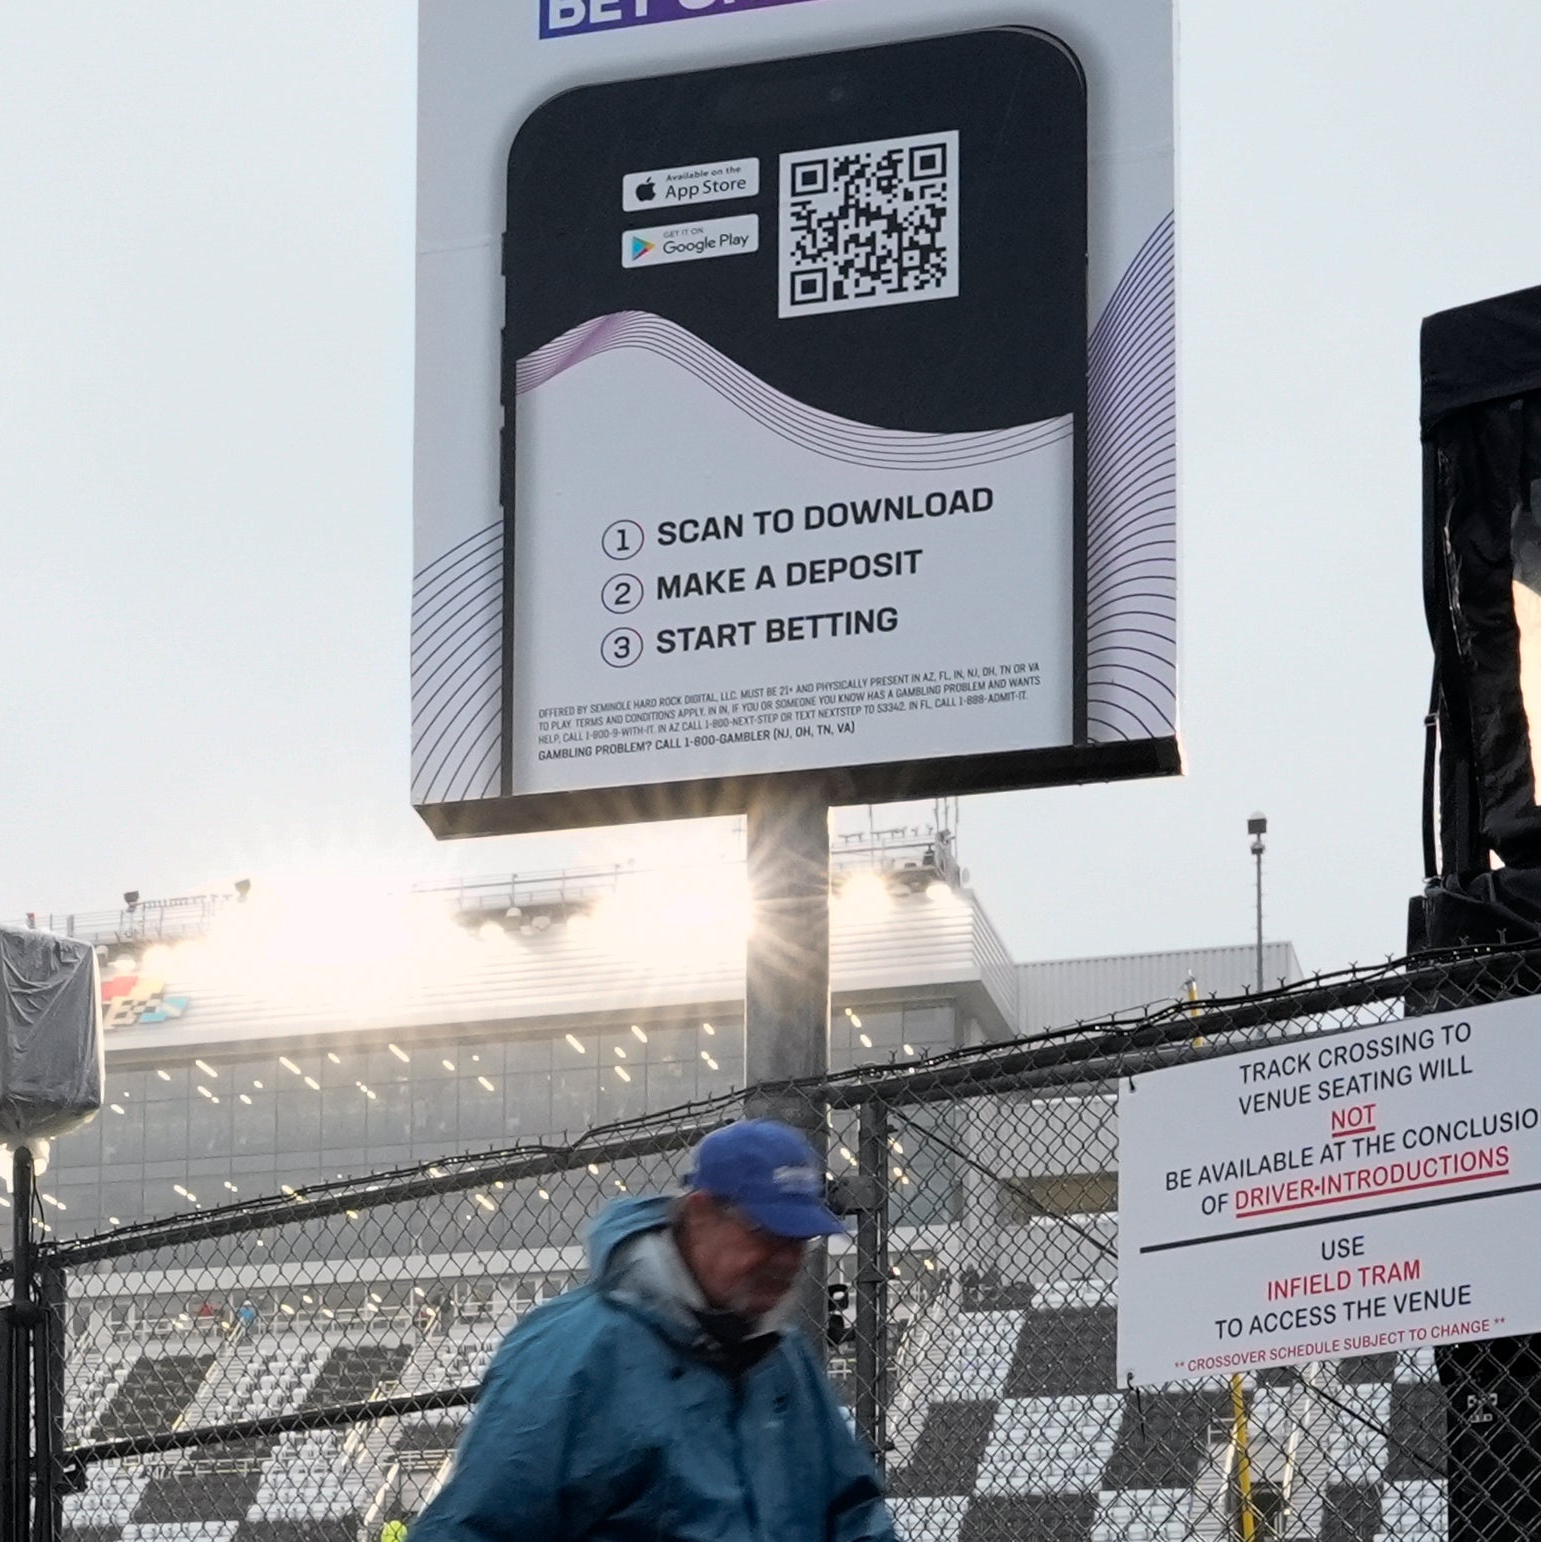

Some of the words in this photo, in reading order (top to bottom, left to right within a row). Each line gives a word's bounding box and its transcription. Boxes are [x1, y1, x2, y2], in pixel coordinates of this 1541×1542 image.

[665, 185, 699, 199] App
[703, 179, 746, 194] Store
[666, 170, 708, 181] Available
[662, 236, 715, 254] Google
[719, 233, 749, 247] Play
[663, 230, 679, 238] GET
[615, 529, 628, 552] 1
[657, 513, 742, 545] SCAN
[752, 508, 793, 535] TO
[804, 487, 992, 530] DOWNLOAD
[612, 581, 631, 606] 2
[657, 567, 745, 599] MAKE
[755, 565, 775, 589] A
[786, 549, 922, 586] DEPOSIT
[612, 635, 630, 659] 3
[656, 620, 756, 653] START
[766, 607, 897, 643] BETTING
[538, 706, 574, 718] OFFERED
[577, 705, 587, 714] BY
[590, 700, 630, 713] SEMINOLE
[633, 698, 656, 708] HARD
[659, 696, 681, 706] ROCK
[684, 693, 718, 704] DIGITAL,
[720, 690, 737, 701] LLC.
[740, 688, 763, 699] MUST
[766, 686, 776, 696] BE
[779, 685, 792, 695] 21+
[795, 683, 813, 693] AND
[816, 678, 867, 691] PHYSICALLY
[870, 674, 908, 686] PRESENT
[911, 673, 920, 682] IN
[922, 671, 936, 681] AZ,
[939, 671, 951, 680] FL,
[953, 669, 964, 679] IN,
[967, 668, 979, 677] NJ,
[982, 666, 997, 676] OH,
[999, 665, 1010, 674] TN
[1013, 663, 1025, 673] OR
[1028, 662, 1039, 671] VA
[539, 721, 548, 731] TO
[551, 719, 571, 729] PLAY.
[576, 716, 603, 727] TERMS
[606, 714, 623, 724] AND
[625, 709, 675, 723] CONDITIONS
[677, 707, 705, 717] APPLY.
[708, 706, 716, 715] IN
[718, 705, 729, 714] IN,
[732, 703, 738, 712] IF
[741, 702, 758, 711] YOU
[760, 700, 772, 710] OR
[775, 696, 815, 709] SOMEONE
[818, 694, 835, 704] YOU
[838, 692, 865, 702] KNOW
[867, 689, 885, 700] HAS
[887, 689, 893, 698] A
[895, 685, 940, 697] GAMBLING
[943, 681, 985, 693] PROBLEM
[988, 679, 1006, 689] AND
[1008, 675, 1040, 687] WANTS
[538, 733, 560, 744] HELP,
[562, 732, 582, 742] CALL
[586, 724, 653, 740] 1-800-9-WITH-IT.
[658, 724, 666, 732] IN
[668, 722, 679, 731] AZ
[681, 720, 702, 731] CALL
[705, 713, 778, 729] 1-800-NEXT-STEP
[780, 711, 792, 721] OR
[795, 709, 815, 720] TEXT
[818, 705, 861, 718] NEXTSTEP
[864, 704, 874, 714] TO
[877, 701, 905, 713] 53342.
[909, 701, 917, 710] IN
[920, 699, 932, 709] FL,
[934, 697, 956, 708] CALL
[959, 690, 1026, 705] 1-888-ADMIT-IT.
[538, 746, 592, 760] GAMBLING
[595, 740, 652, 755] PROBLEM?
[655, 738, 681, 750] CALL
[685, 729, 769, 747] 1-800-GAMBLER
[773, 728, 792, 740] (NJ,
[795, 725, 813, 737] OH,
[817, 724, 833, 735] TN,
[837, 720, 854, 733] VA)
[1239, 1052, 1311, 1083] TRACK
[1318, 1029, 1433, 1068] CROSSING
[1440, 1022, 1470, 1045] TO
[1238, 1084, 1311, 1114] VENUE
[1318, 1065, 1411, 1100] SEATING
[1418, 1055, 1472, 1081] WILL
[1332, 1104, 1375, 1130] NOT
[1166, 1168, 1191, 1190] BE
[1198, 1146, 1313, 1185] AVAILABLE
[1320, 1140, 1345, 1164] AT
[1352, 1132, 1395, 1157] THE
[1402, 1106, 1541, 1149] CONCLUSIO
[1201, 1193, 1228, 1215] OF
[1236, 1145, 1508, 1209] DRIVER-INTRODUCTIONS
[1321, 1235, 1364, 1260] USE
[1268, 1270, 1350, 1300] INFIELD
[1357, 1259, 1419, 1287] TRAM
[1215, 1317, 1242, 1339] TO
[1249, 1303, 1336, 1334] ACCESS
[1342, 1296, 1386, 1320] THE
[1393, 1284, 1470, 1313] VENUE
[1187, 1349, 1265, 1371] CROSSOVER
[1269, 1339, 1339, 1360] SCHEDULE
[1343, 1330, 1405, 1350] SUBJECT
[1408, 1327, 1426, 1341] TO
[1430, 1318, 1489, 1338] CHANGE
